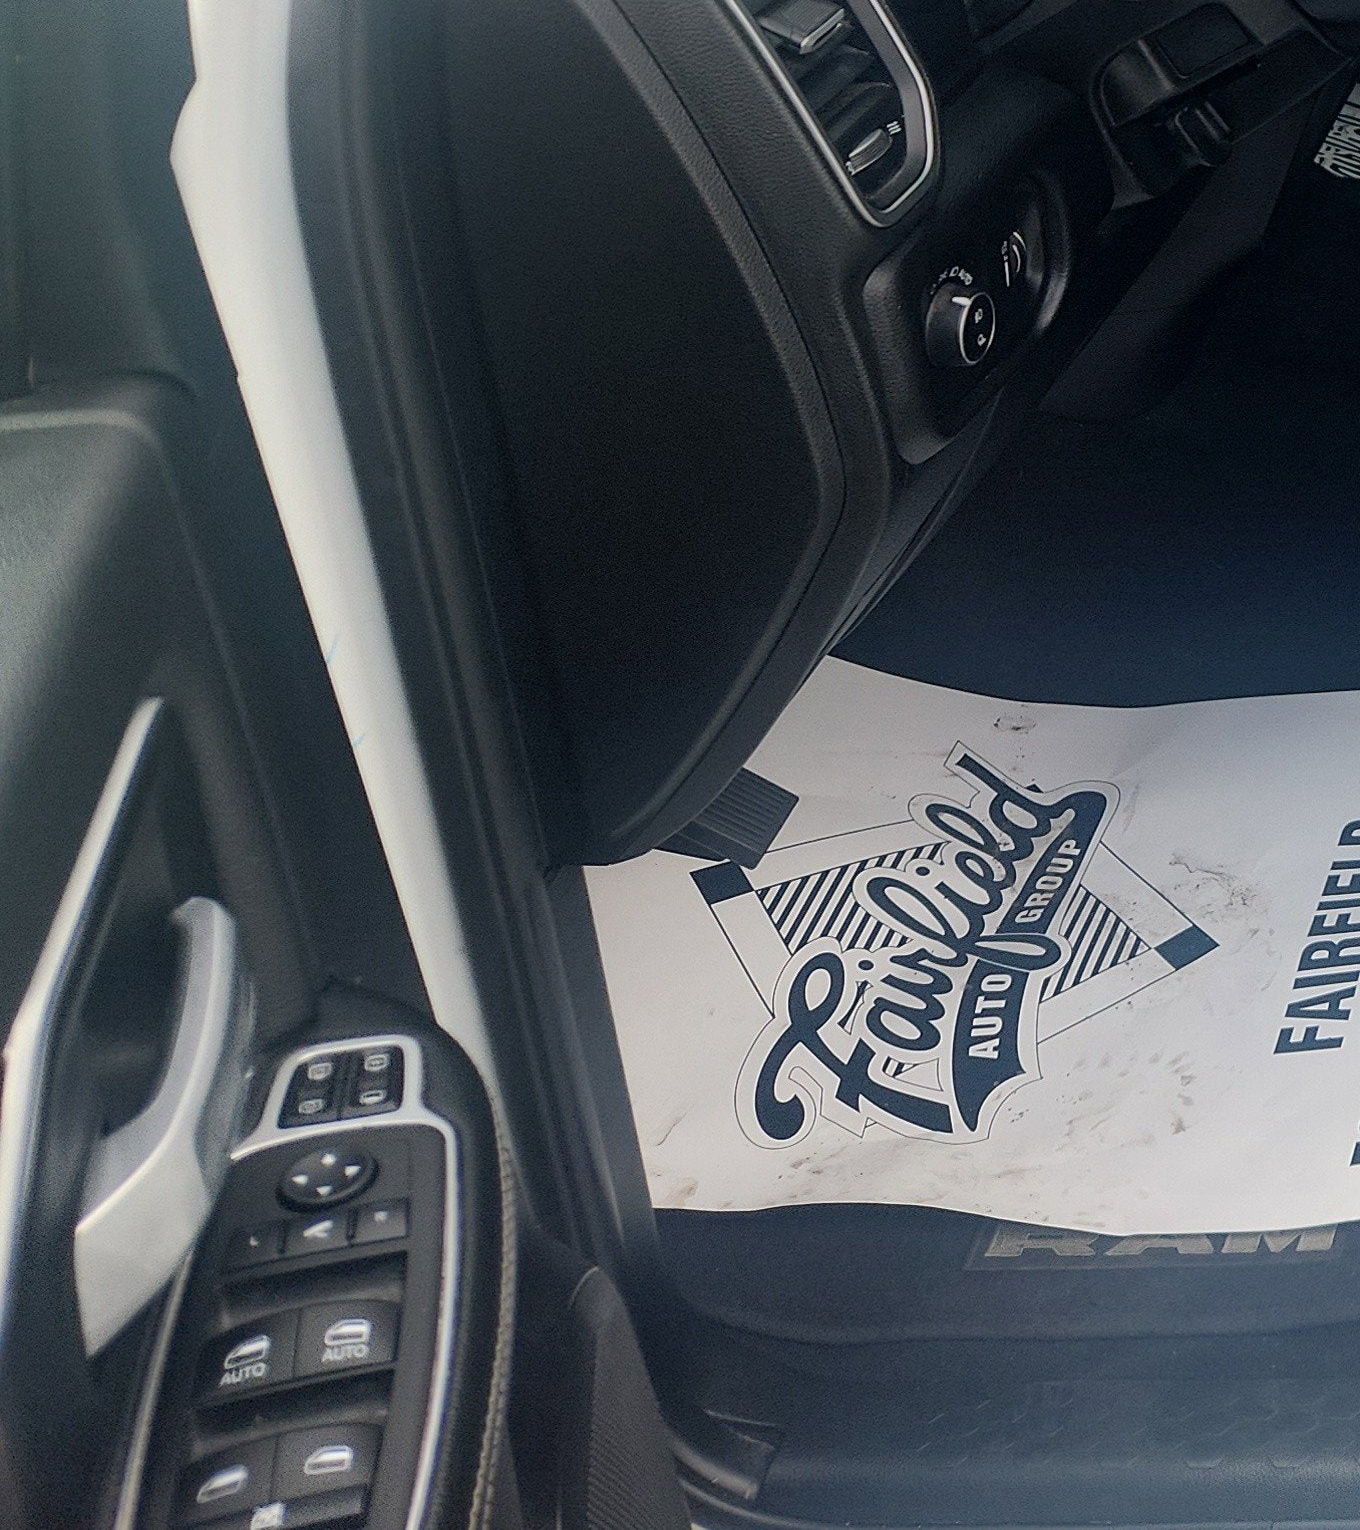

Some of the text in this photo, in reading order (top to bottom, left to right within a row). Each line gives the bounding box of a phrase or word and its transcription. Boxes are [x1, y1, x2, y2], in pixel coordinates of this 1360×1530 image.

[755, 753, 1108, 1140] Fairfield
[969, 839, 1082, 1059] AUTO GROUP
[984, 1222, 1337, 1257] RAM
[319, 1343, 370, 1363] AUTO
[218, 1362, 266, 1388] AUTO
